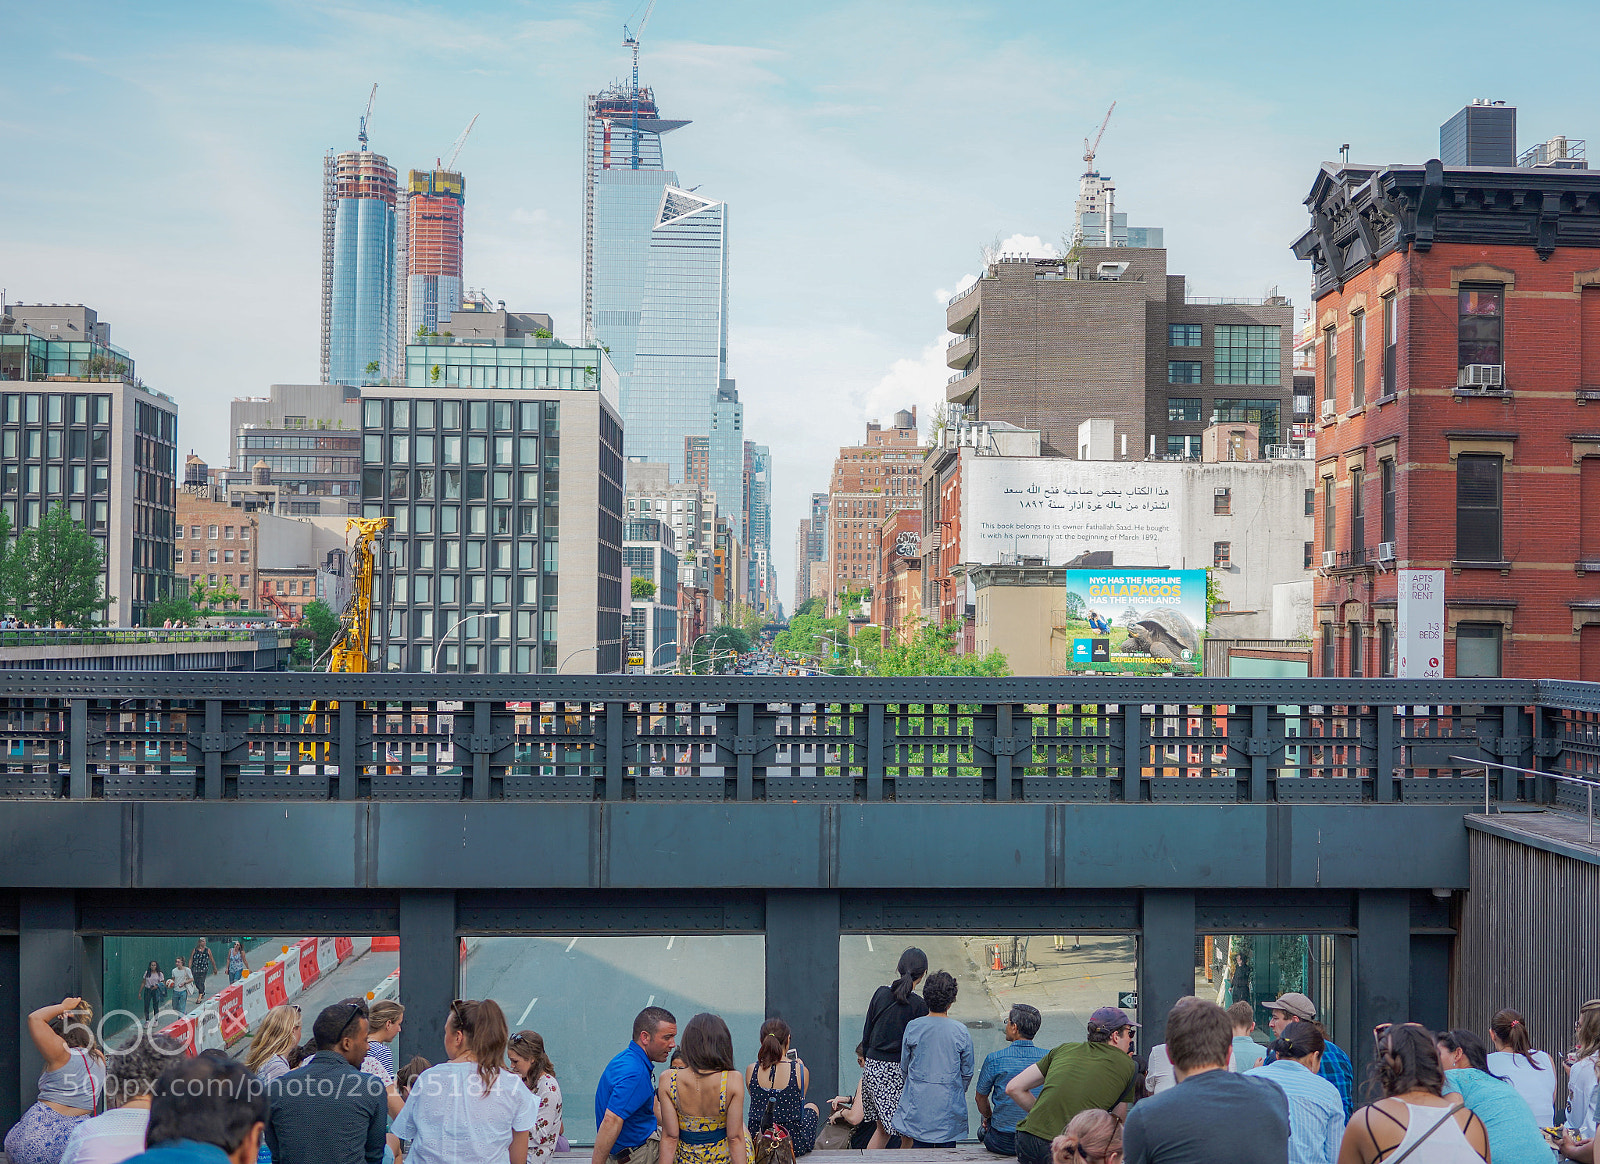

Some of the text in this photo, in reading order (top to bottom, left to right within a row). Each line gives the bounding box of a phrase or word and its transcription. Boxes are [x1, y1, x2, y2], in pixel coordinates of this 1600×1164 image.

[1026, 482, 1040, 494] الله
[1044, 486, 1059, 498] فتح
[1126, 486, 1152, 498] الكتاب
[1155, 486, 1169, 496] هذا
[1126, 502, 1139, 512] من
[1016, 523, 1041, 531] belongs
[1146, 524, 1170, 533] bought
[1031, 533, 1054, 541] money
[1077, 533, 1108, 541] beginning
[1089, 576, 1182, 585] NYC HAS THE HIGHLINE
[1412, 574, 1433, 582] APTS
[1412, 583, 1430, 591] FOR
[1412, 591, 1434, 600] RENT
[1089, 596, 1181, 605] HAS THE HIGHLANDS
[1428, 622, 1440, 631] 1-3
[1419, 631, 1440, 639] BEDS
[1423, 670, 1440, 678] 646
